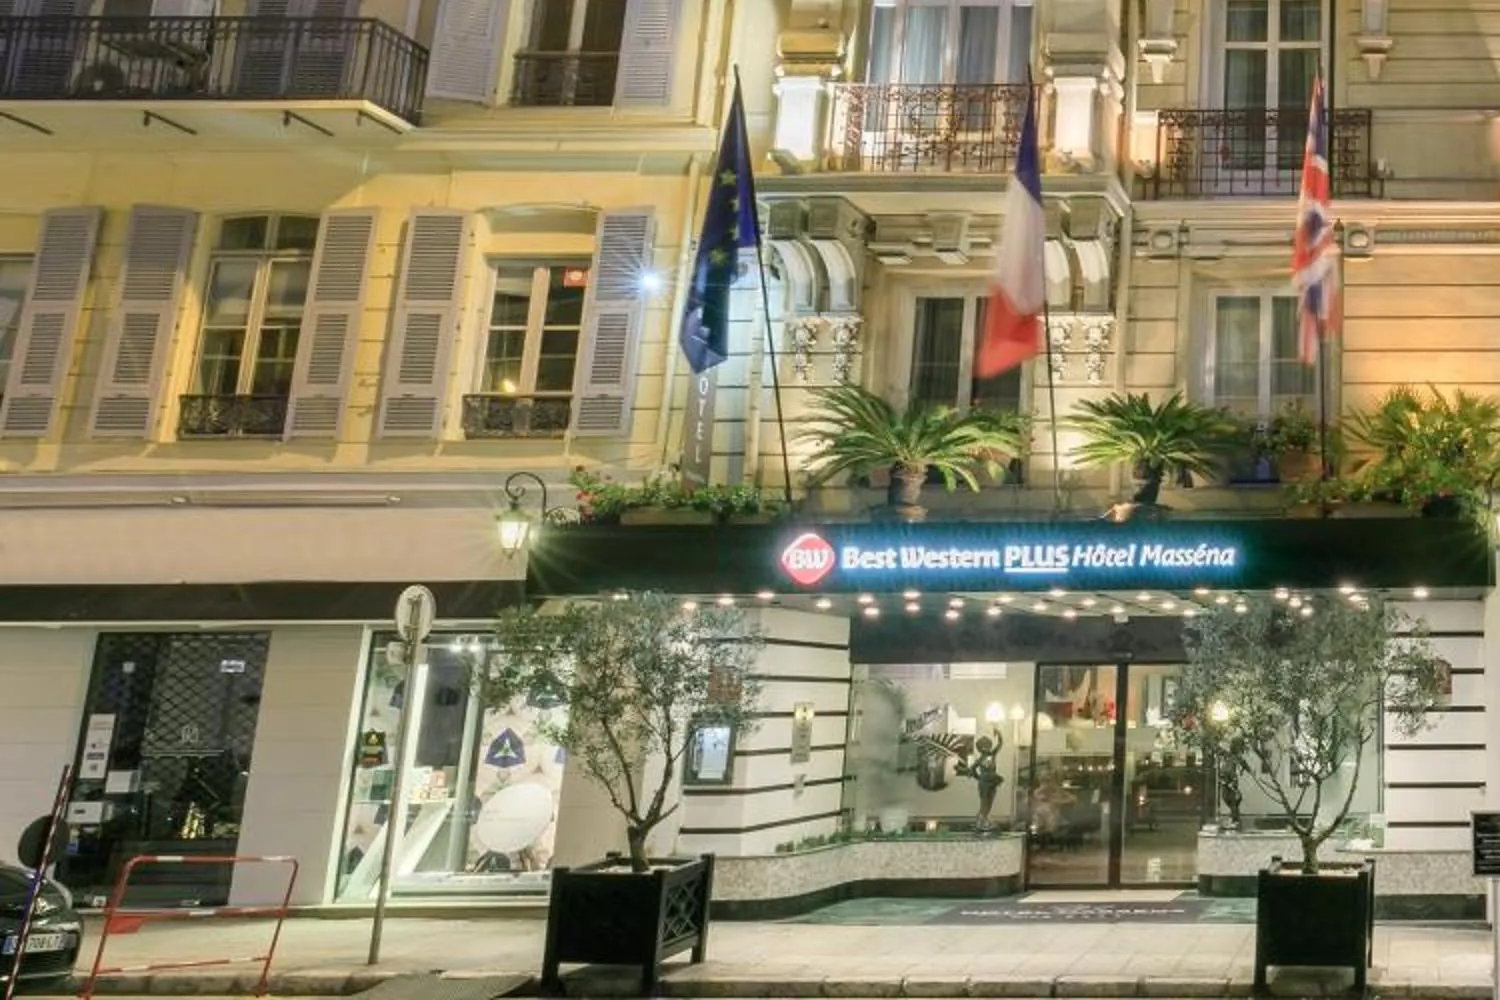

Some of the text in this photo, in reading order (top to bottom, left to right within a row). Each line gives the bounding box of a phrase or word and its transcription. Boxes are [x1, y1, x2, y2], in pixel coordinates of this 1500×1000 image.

[695, 377, 709, 464] OTEL
[788, 543, 1235, 571] BW Best Western PLUS Hôtel Masséna
